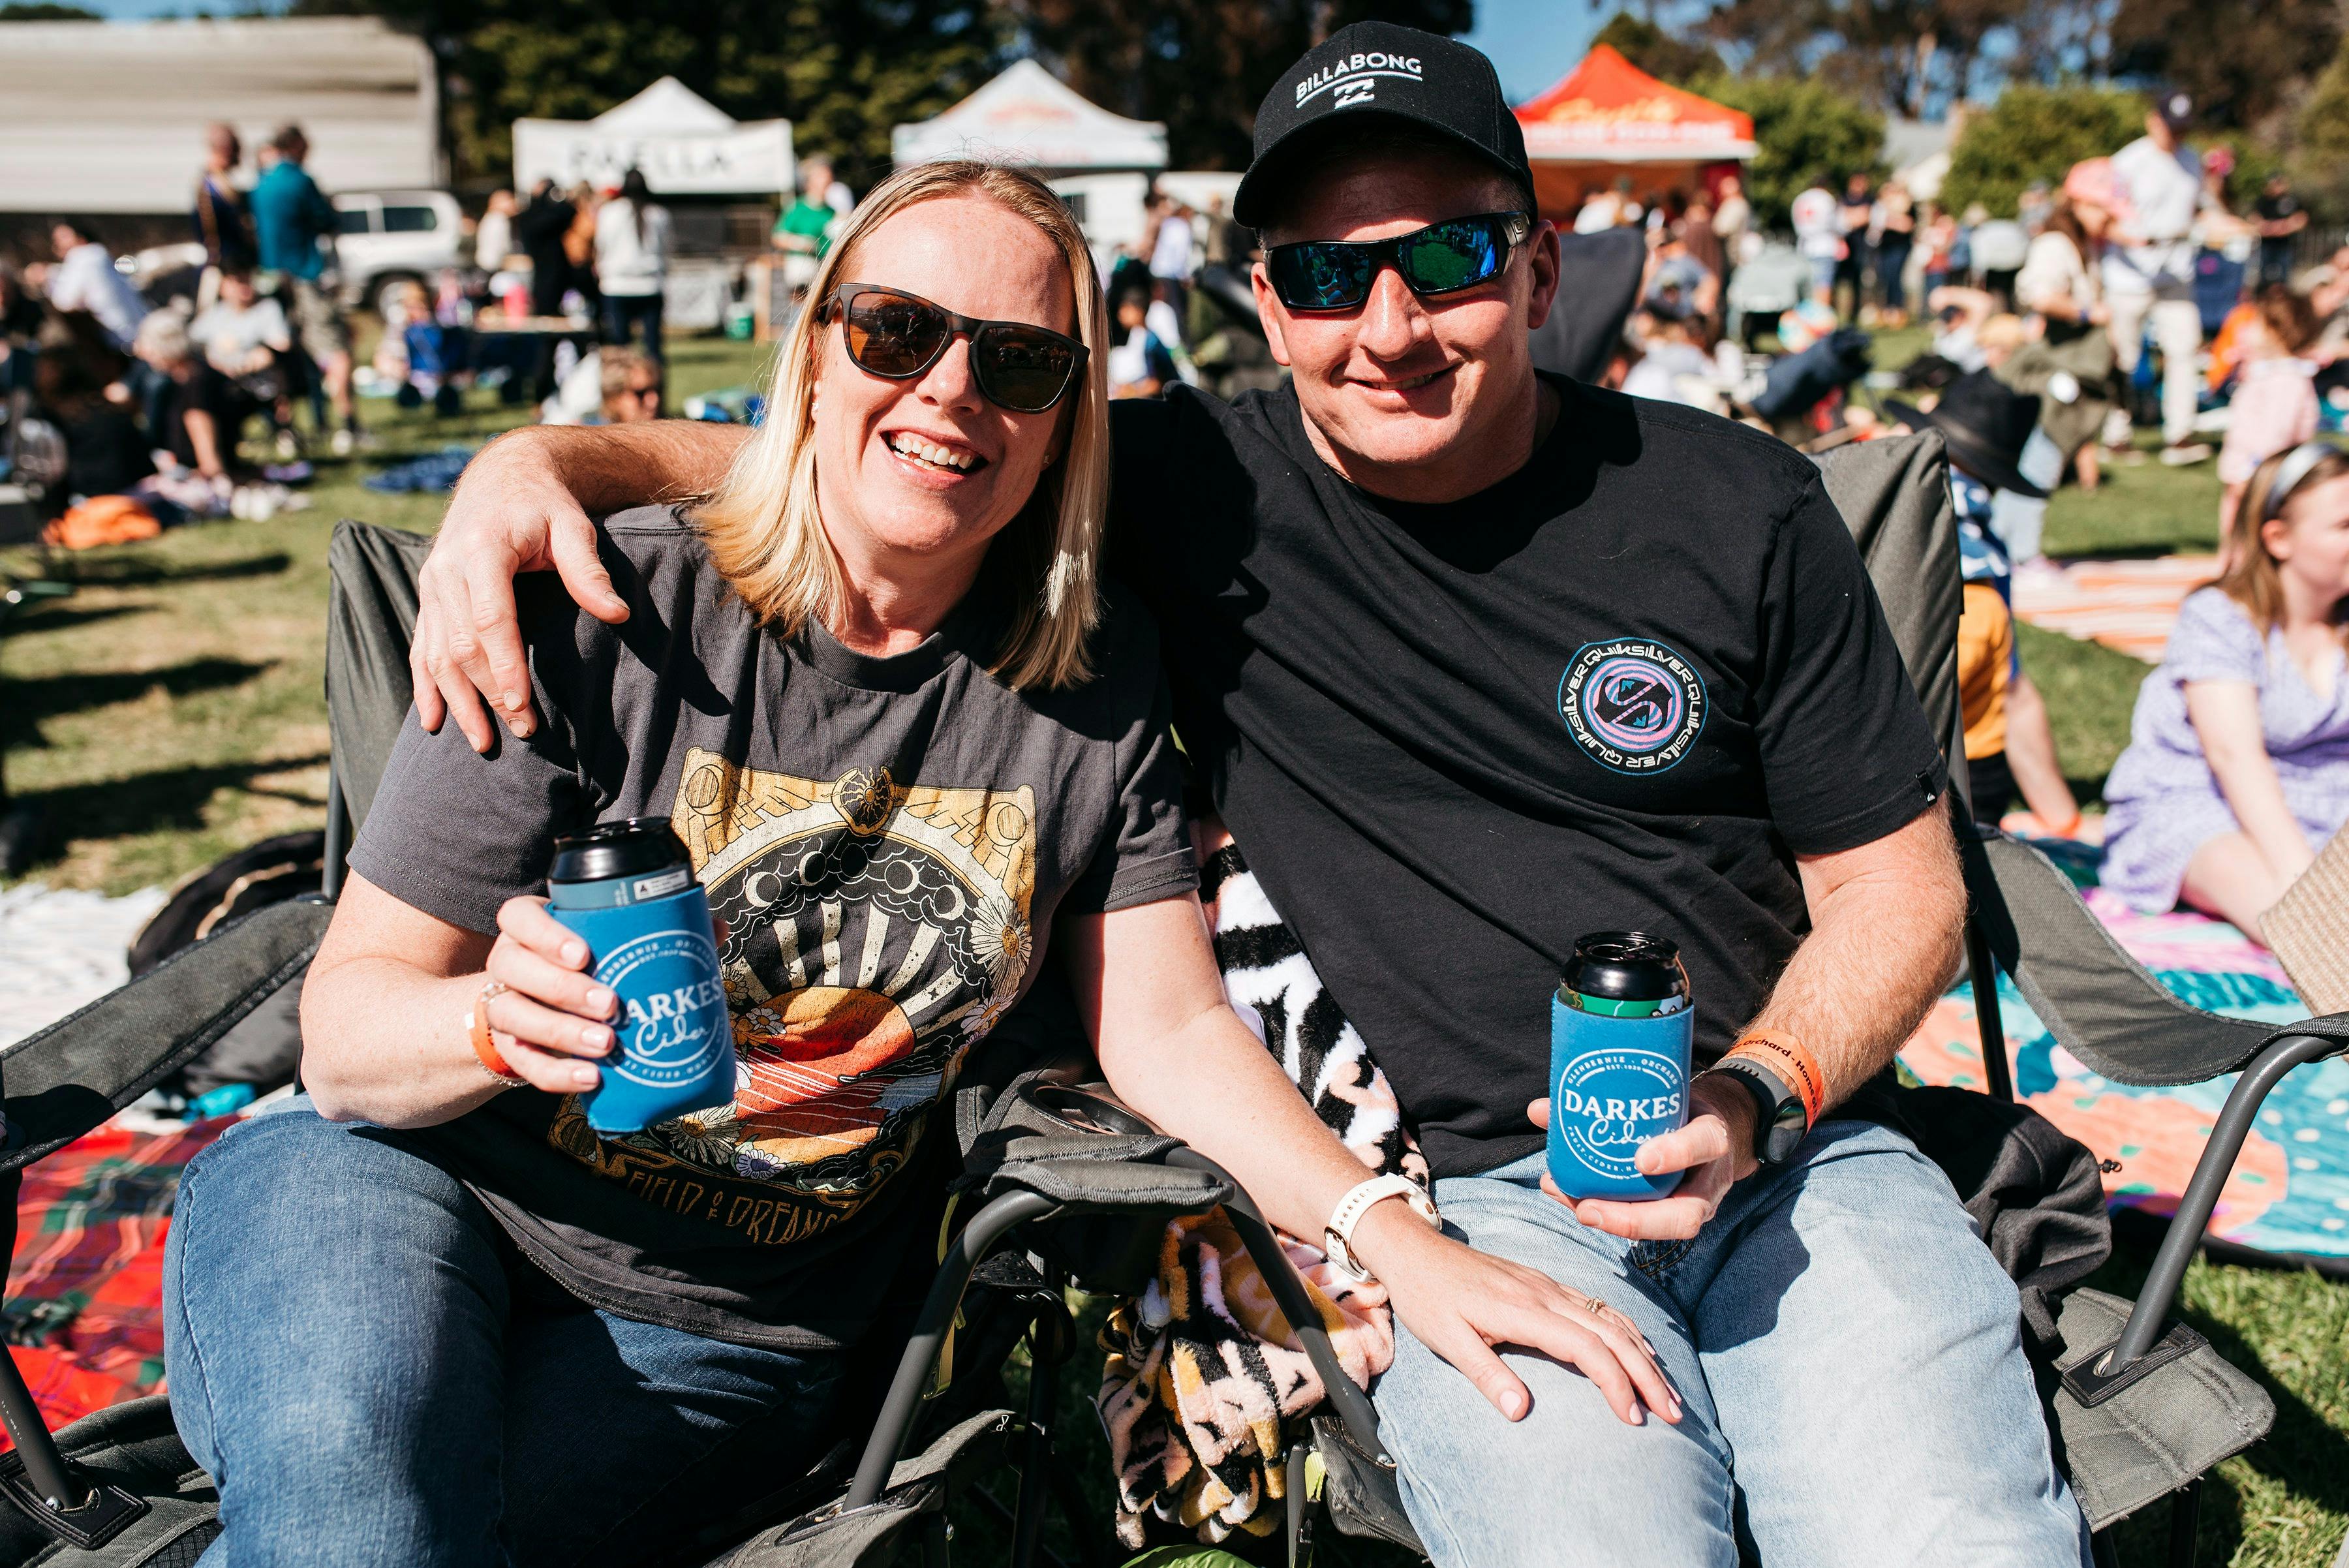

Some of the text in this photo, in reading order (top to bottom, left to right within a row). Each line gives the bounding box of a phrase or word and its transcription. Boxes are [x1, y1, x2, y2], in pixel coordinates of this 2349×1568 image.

[1296, 52, 1422, 101] BILLABONG
[613, 977, 722, 1026] ARKES
[635, 1014, 708, 1057] Cider
[1743, 1039, 1792, 1058] Orchard
[1795, 1060, 1815, 1096] Home
[1565, 1089, 1681, 1121] DARKES
[1588, 1117, 1653, 1147] Cider
